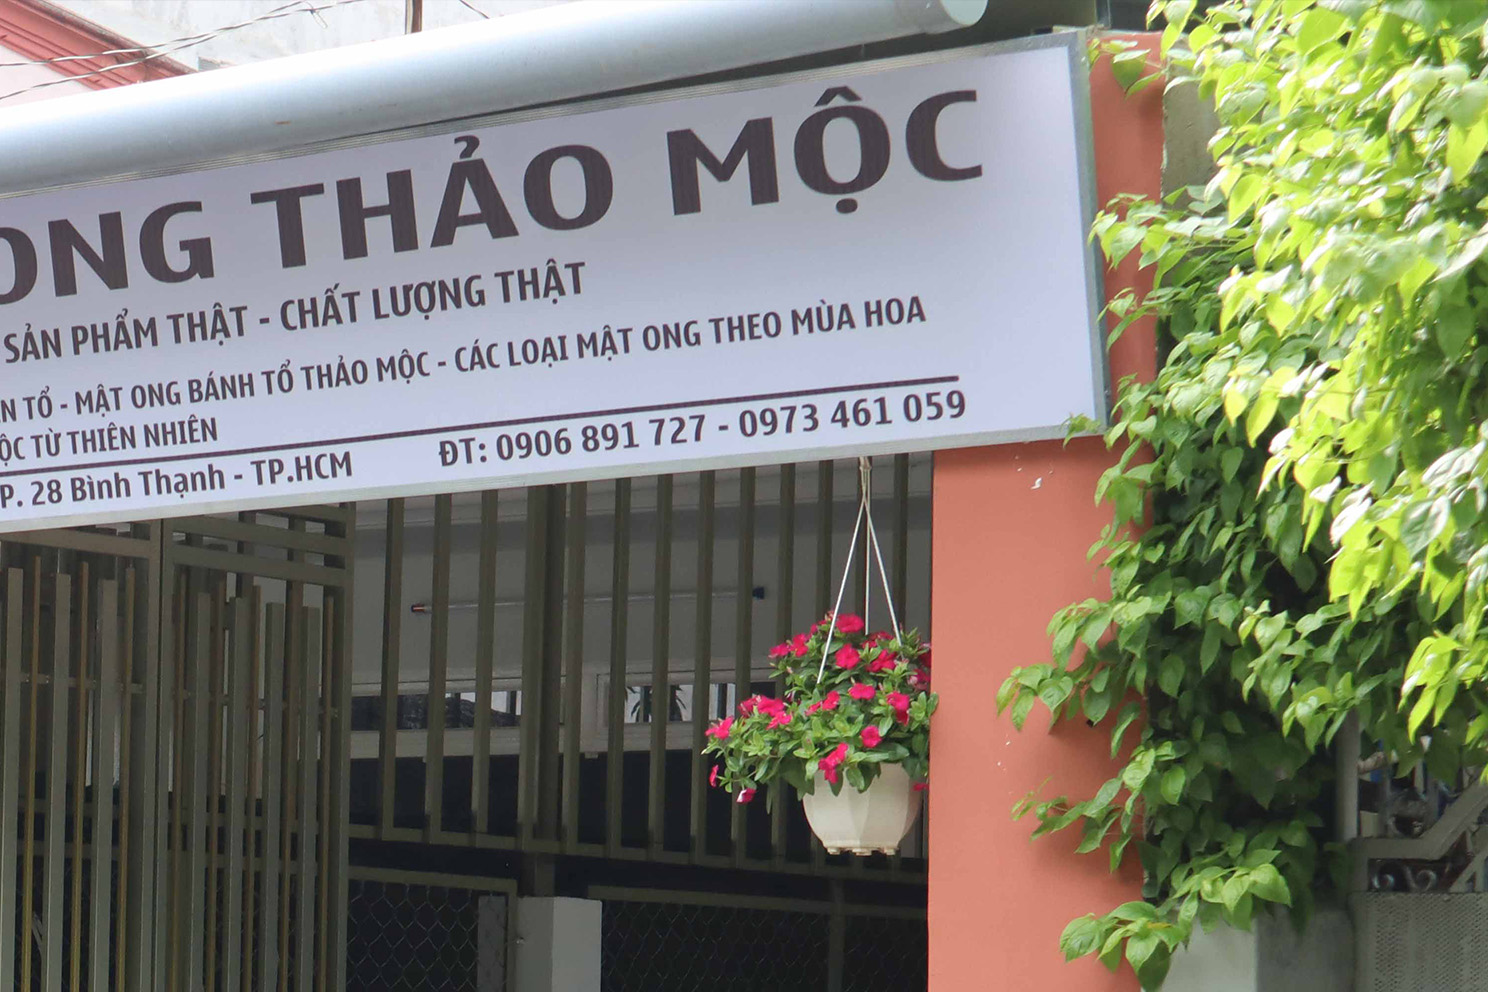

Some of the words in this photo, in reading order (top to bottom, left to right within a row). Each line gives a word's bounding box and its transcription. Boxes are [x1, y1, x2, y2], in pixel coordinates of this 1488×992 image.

[250, 135, 614, 270] THẢO
[666, 86, 984, 216] MỘC
[3, 323, 62, 364] SẢN
[71, 308, 159, 356] PHẨM
[166, 302, 248, 346] THẬT
[280, 283, 361, 331] CHẤT
[372, 275, 486, 320] LƯỢNG
[494, 258, 586, 305] THẬT
[22, 385, 53, 420] TỔ
[74, 384, 124, 418] MẬT
[130, 381, 182, 410] ONG
[187, 371, 256, 403] BÁNH
[261, 359, 295, 396] TỔ
[300, 355, 369, 391] THẢO
[376, 348, 430, 385] MỘC
[454, 339, 500, 372] CÁC
[507, 335, 569, 368] LOẠI
[576, 325, 634, 361] MẬT
[642, 320, 702, 352] ONG
[708, 311, 782, 344] THEO
[790, 299, 856, 336] MÙA
[863, 295, 927, 328] HOA
[30, 428, 62, 459] TỪ
[66, 422, 137, 454] THIÊN
[143, 414, 219, 448] NHIÊN
[438, 437, 488, 467] ĐT:
[496, 427, 572, 461] 0906
[581, 421, 640, 452] 891
[649, 414, 706, 446] 727
[738, 403, 820, 438] 0973
[830, 396, 893, 429] 461
[903, 389, 966, 423] 059
[0, 483, 24, 509] P.
[30, 479, 64, 507] 28
[70, 472, 132, 502] Bình
[138, 463, 226, 499] Thạnh
[250, 450, 353, 486] TP.HCM
